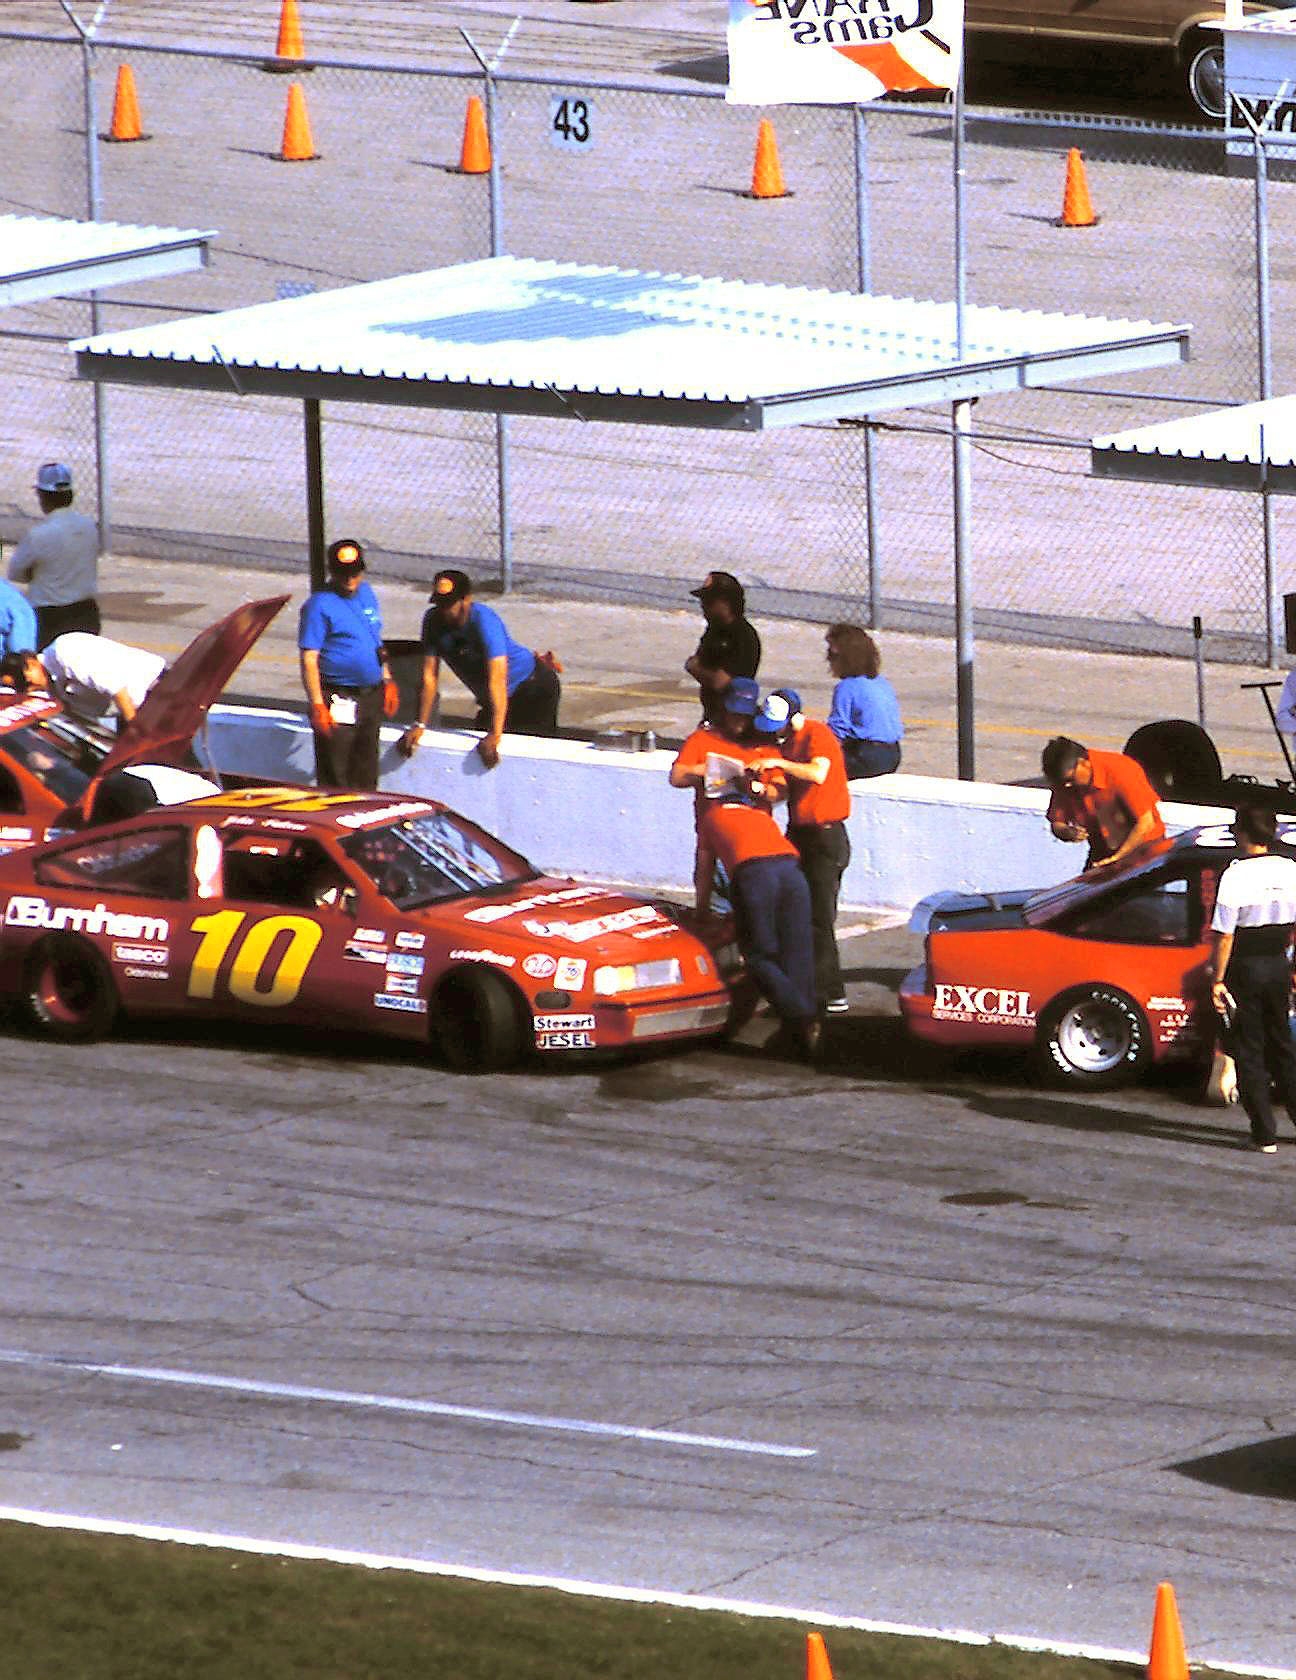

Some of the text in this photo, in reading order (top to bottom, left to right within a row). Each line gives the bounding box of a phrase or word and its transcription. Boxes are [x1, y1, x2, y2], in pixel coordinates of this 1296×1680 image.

[554, 100, 589, 142] 43
[7, 896, 169, 941] Burnham
[187, 909, 323, 1007] 10
[934, 984, 1036, 1018] EXCEL
[537, 1017, 592, 1030] Stewart
[931, 1010, 1037, 1027] SERVICES CORPORATION
[540, 1034, 593, 1047] JESEL
